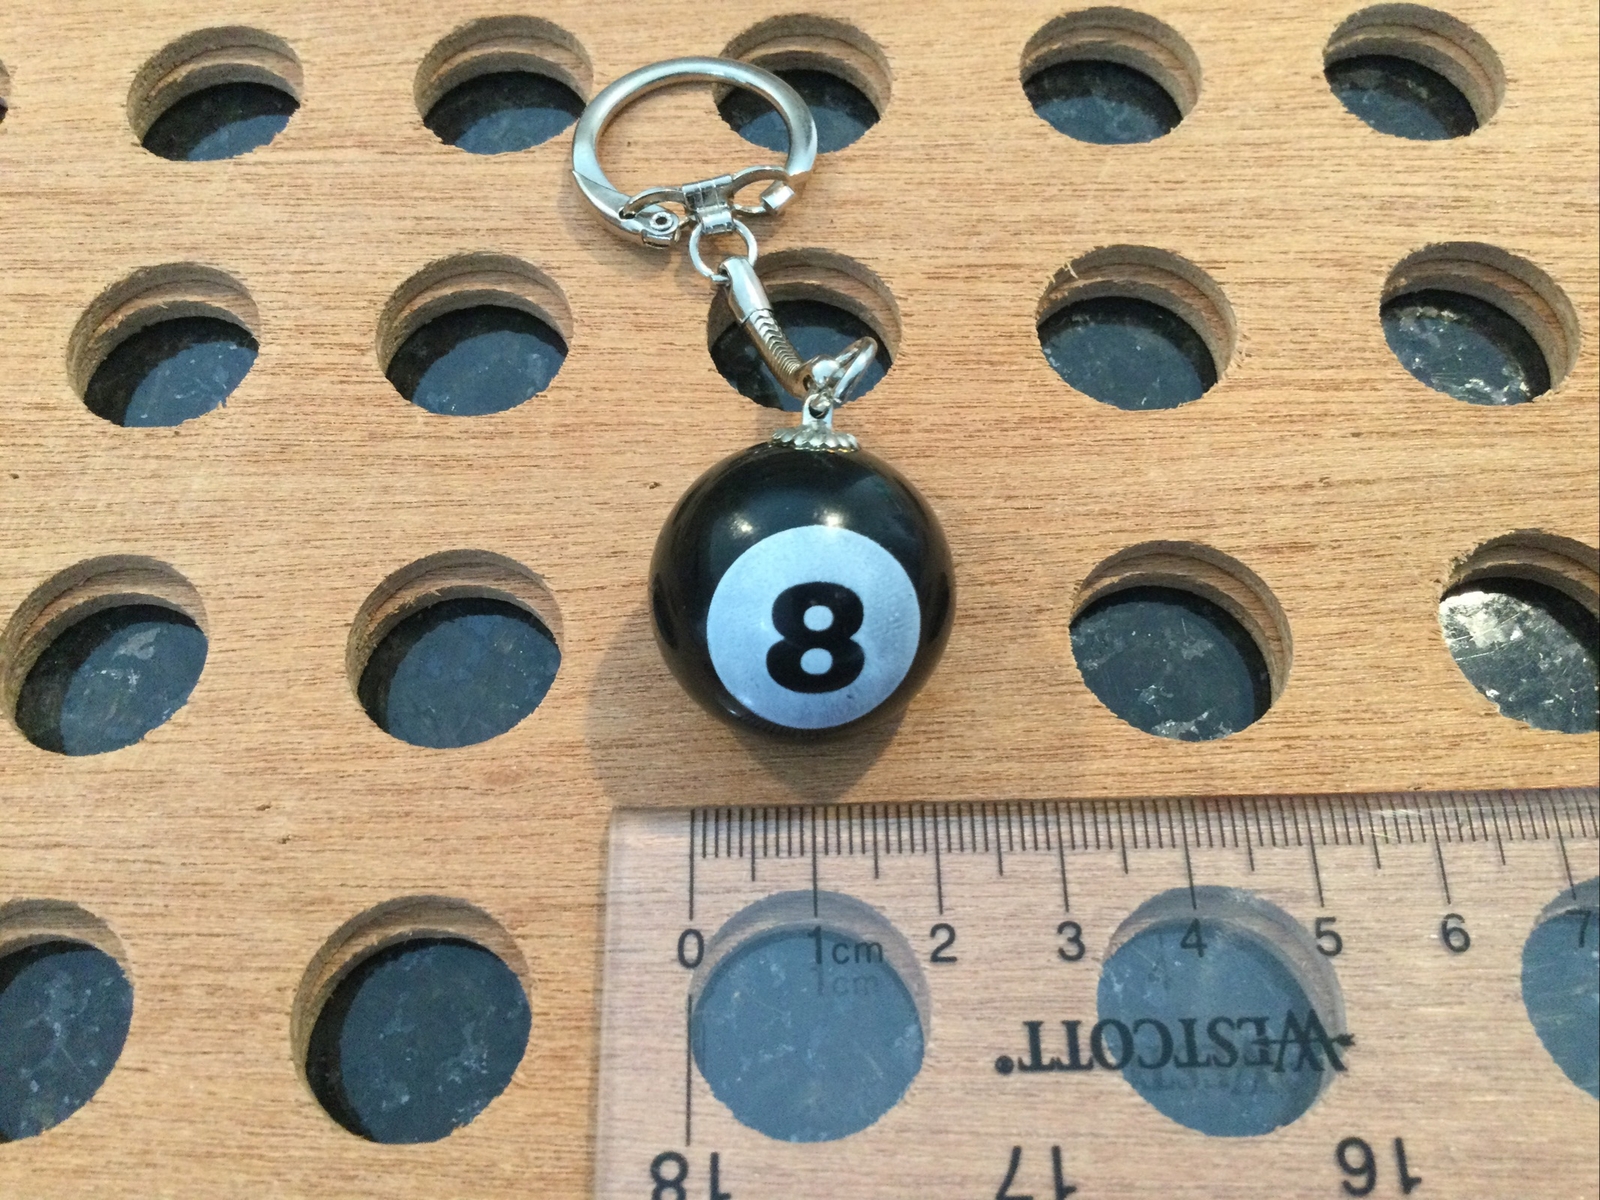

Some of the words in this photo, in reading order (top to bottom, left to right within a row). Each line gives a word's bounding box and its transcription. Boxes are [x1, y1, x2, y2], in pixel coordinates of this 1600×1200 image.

[766, 581, 865, 694] 8
[677, 929, 704, 969] 0
[929, 923, 958, 963] 2
[1056, 921, 1086, 961] 3
[1180, 919, 1207, 958] 4
[1314, 917, 1343, 957] 5
[1440, 913, 1471, 952] 6
[1564, 909, 1591, 948] 7
[649, 1151, 732, 1200] 18
[1334, 1136, 1422, 1197] 16
